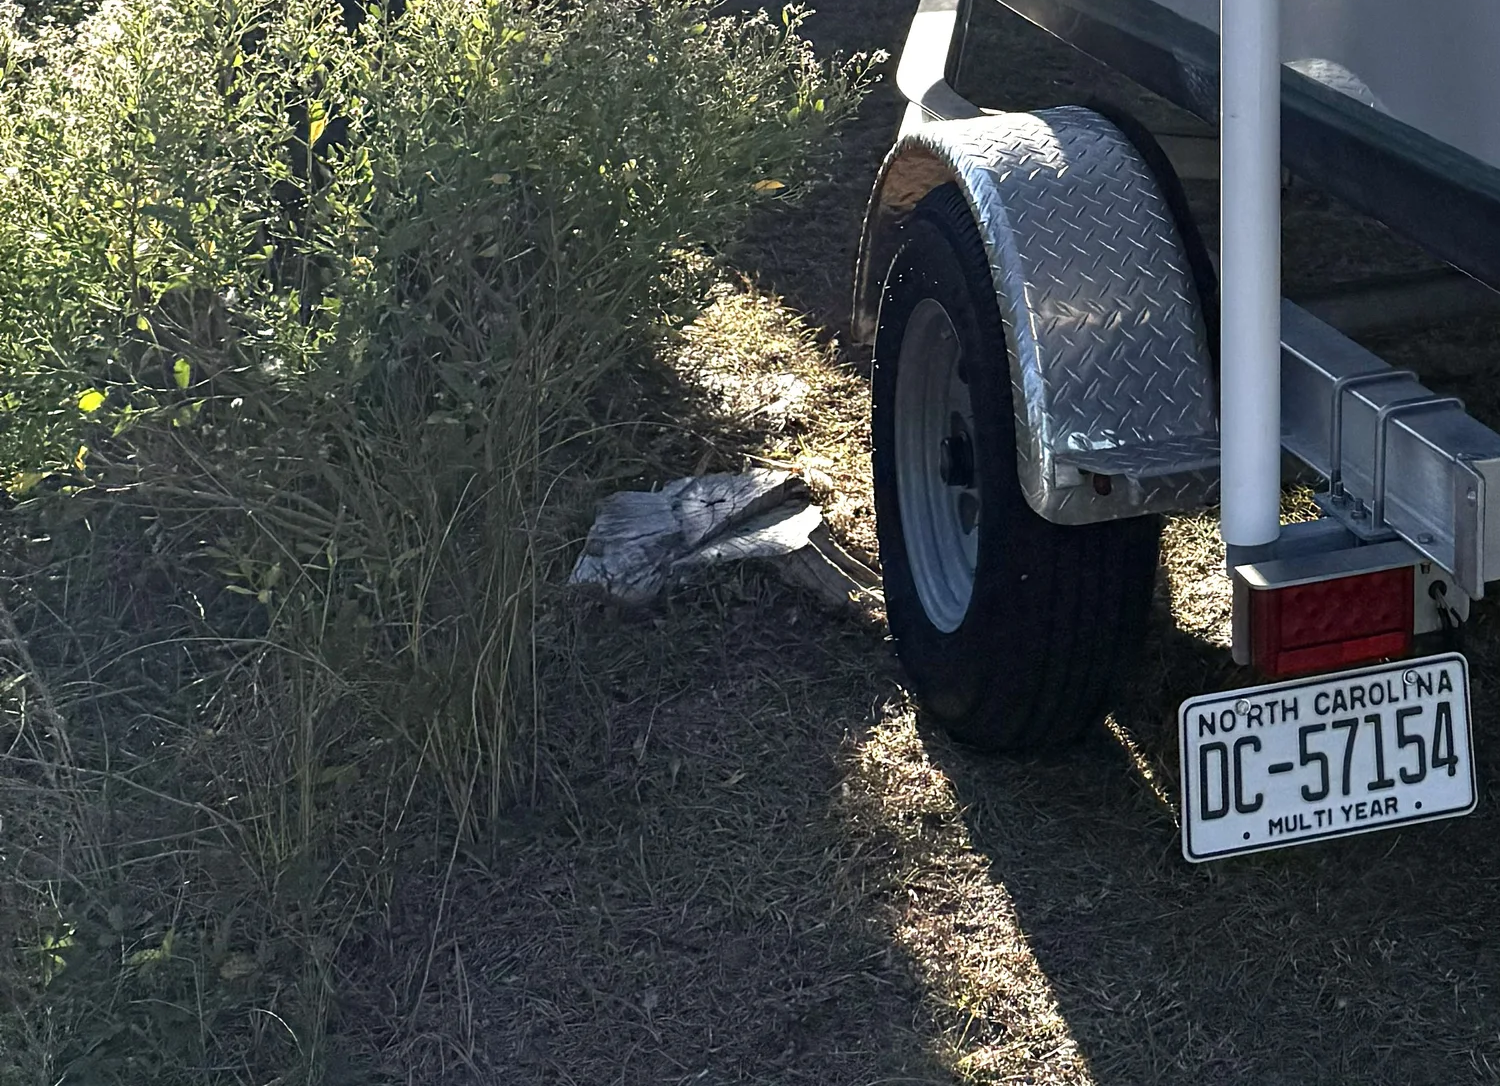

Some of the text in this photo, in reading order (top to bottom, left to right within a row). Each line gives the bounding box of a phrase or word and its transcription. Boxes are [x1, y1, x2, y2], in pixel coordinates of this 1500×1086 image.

[1198, 670, 1454, 738] NORTH CAROLINA
[1199, 701, 1459, 821] DC-57154
[1268, 797, 1399, 836] MULTI YEAR
